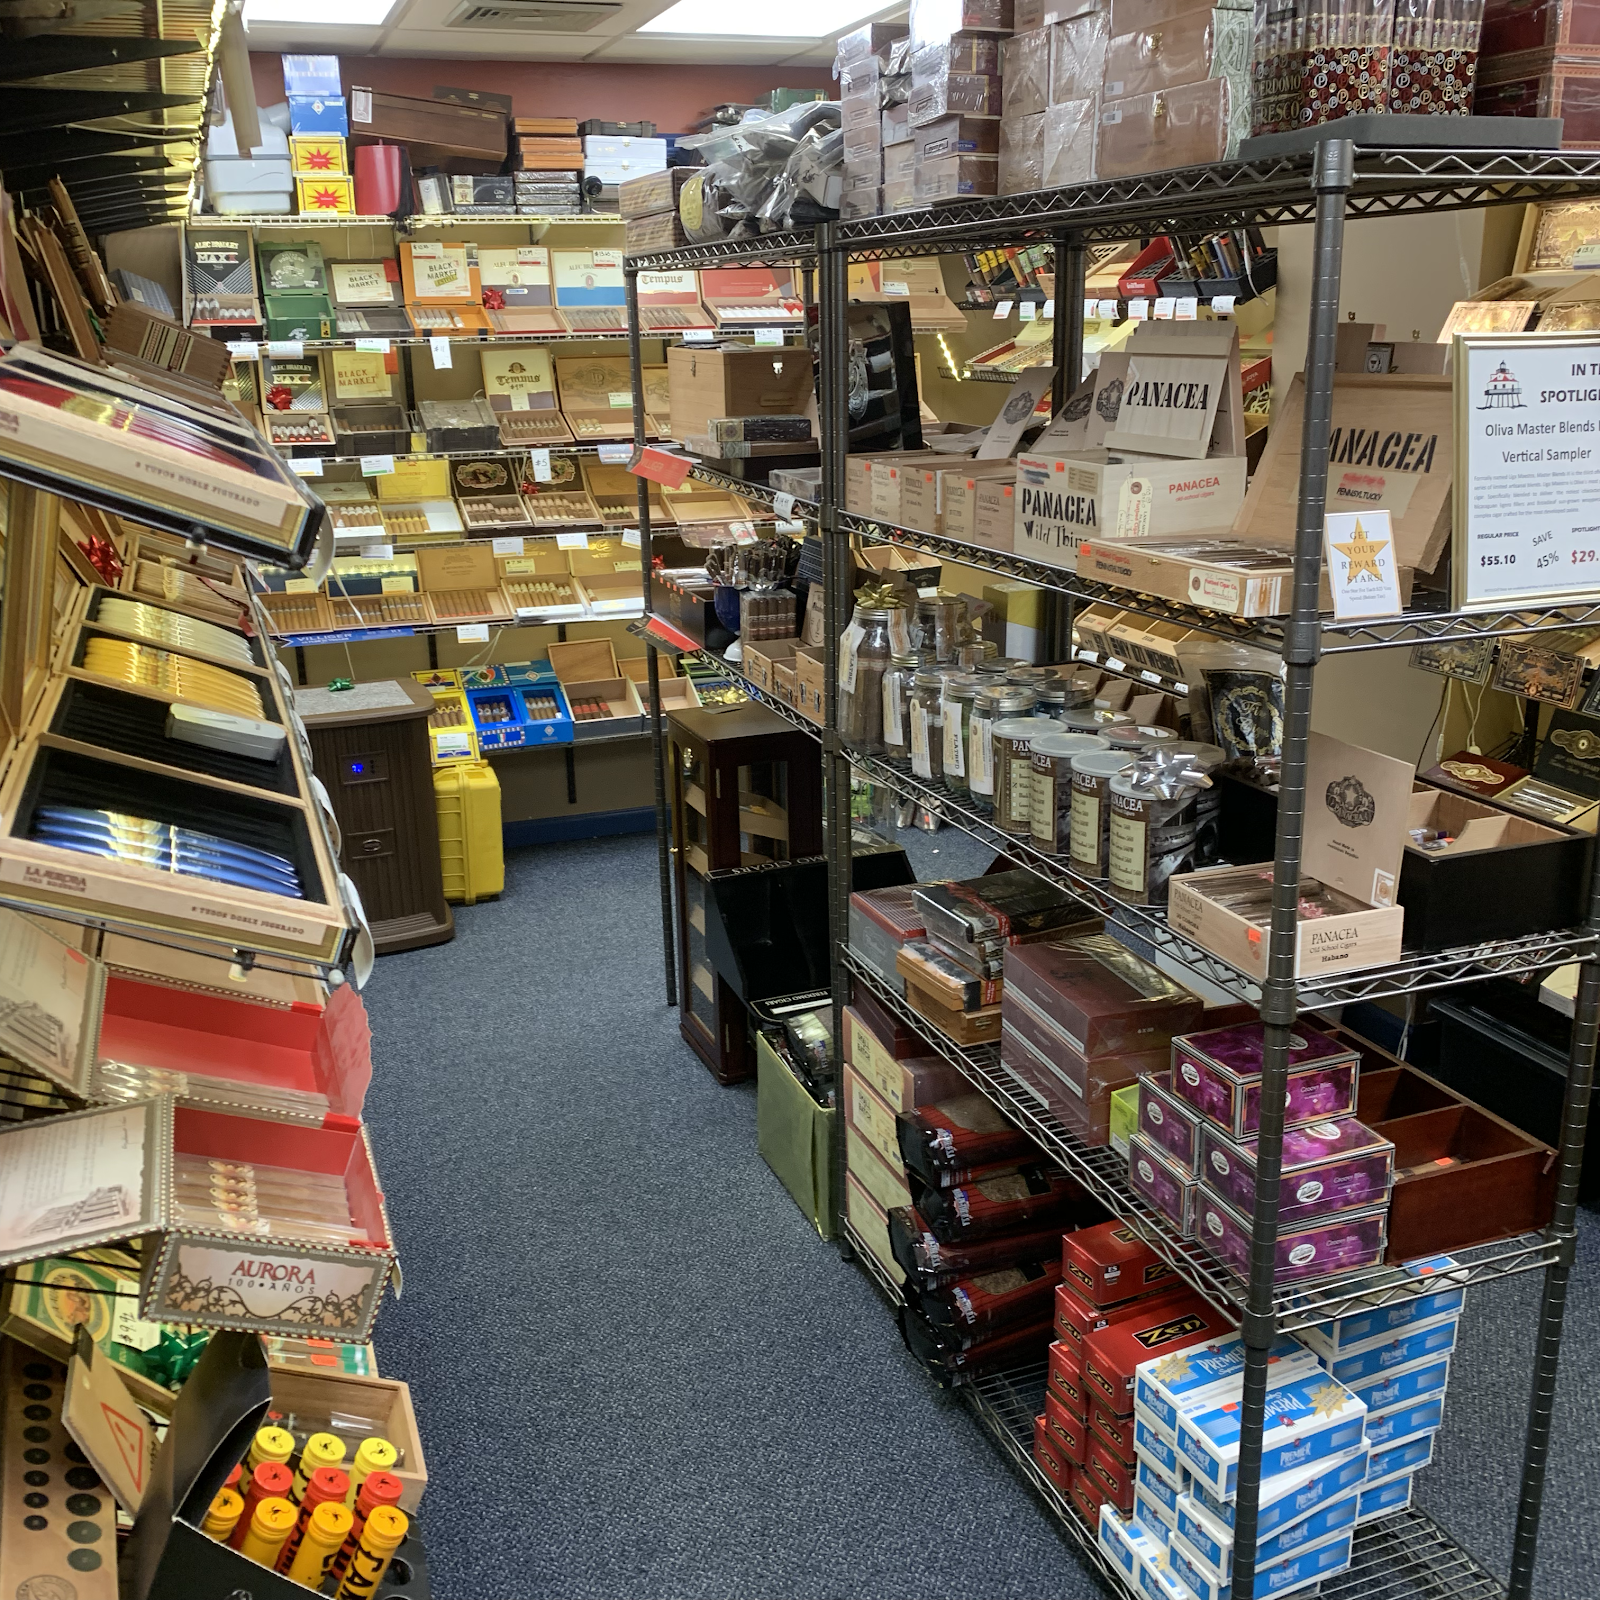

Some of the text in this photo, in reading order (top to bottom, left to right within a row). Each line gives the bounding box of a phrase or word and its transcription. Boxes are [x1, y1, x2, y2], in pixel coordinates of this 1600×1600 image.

[1253, 75, 1301, 97] PERDOMO
[1254, 101, 1300, 125] FRESCO
[428, 262, 453, 272] BLACK
[349, 274, 374, 283] BLACK
[427, 269, 458, 280] MARKET
[641, 274, 684, 285] Tempus
[348, 280, 379, 289] MARKET
[338, 369, 367, 378] BLACK
[1571, 363, 1586, 376] IN
[338, 376, 376, 387] MARKET
[1126, 381, 1210, 410] PANACEA
[1540, 389, 1600, 403] SPOTLIG
[1485, 420, 1595, 437] Oliva Master Blends
[1328, 427, 1438, 473] ANACEA
[1502, 447, 1592, 463] Vertical Sampler
[1168, 477, 1220, 494] PANACEA
[1022, 487, 1097, 527] PANACEA
[1023, 520, 1089, 549] Wild Thin
[1350, 531, 1369, 540] GET
[1477, 532, 1503, 540] REGULAR
[1532, 530, 1553, 547] SAVE
[1347, 545, 1376, 554] YOUR
[1341, 559, 1385, 569] REWARD
[1480, 554, 1516, 568] $55.10
[1536, 550, 1560, 569] 45%
[1571, 549, 1600, 565] $29.
[1347, 573, 1383, 583] STARS!
[296, 633, 352, 642] VILLIGER
[1174, 888, 1203, 913] PANACEA
[1311, 927, 1359, 945] PANACEA
[1309, 941, 1357, 954] Old School Cigars
[1321, 953, 1349, 963] Habano
[792, 991, 828, 1001] PERDOMO
[231, 1259, 316, 1286] AURORA
[1107, 1265, 1118, 1273] ES
[268, 1280, 316, 1295] AÑOS
[1280, 1442, 1311, 1466] PREMIER
